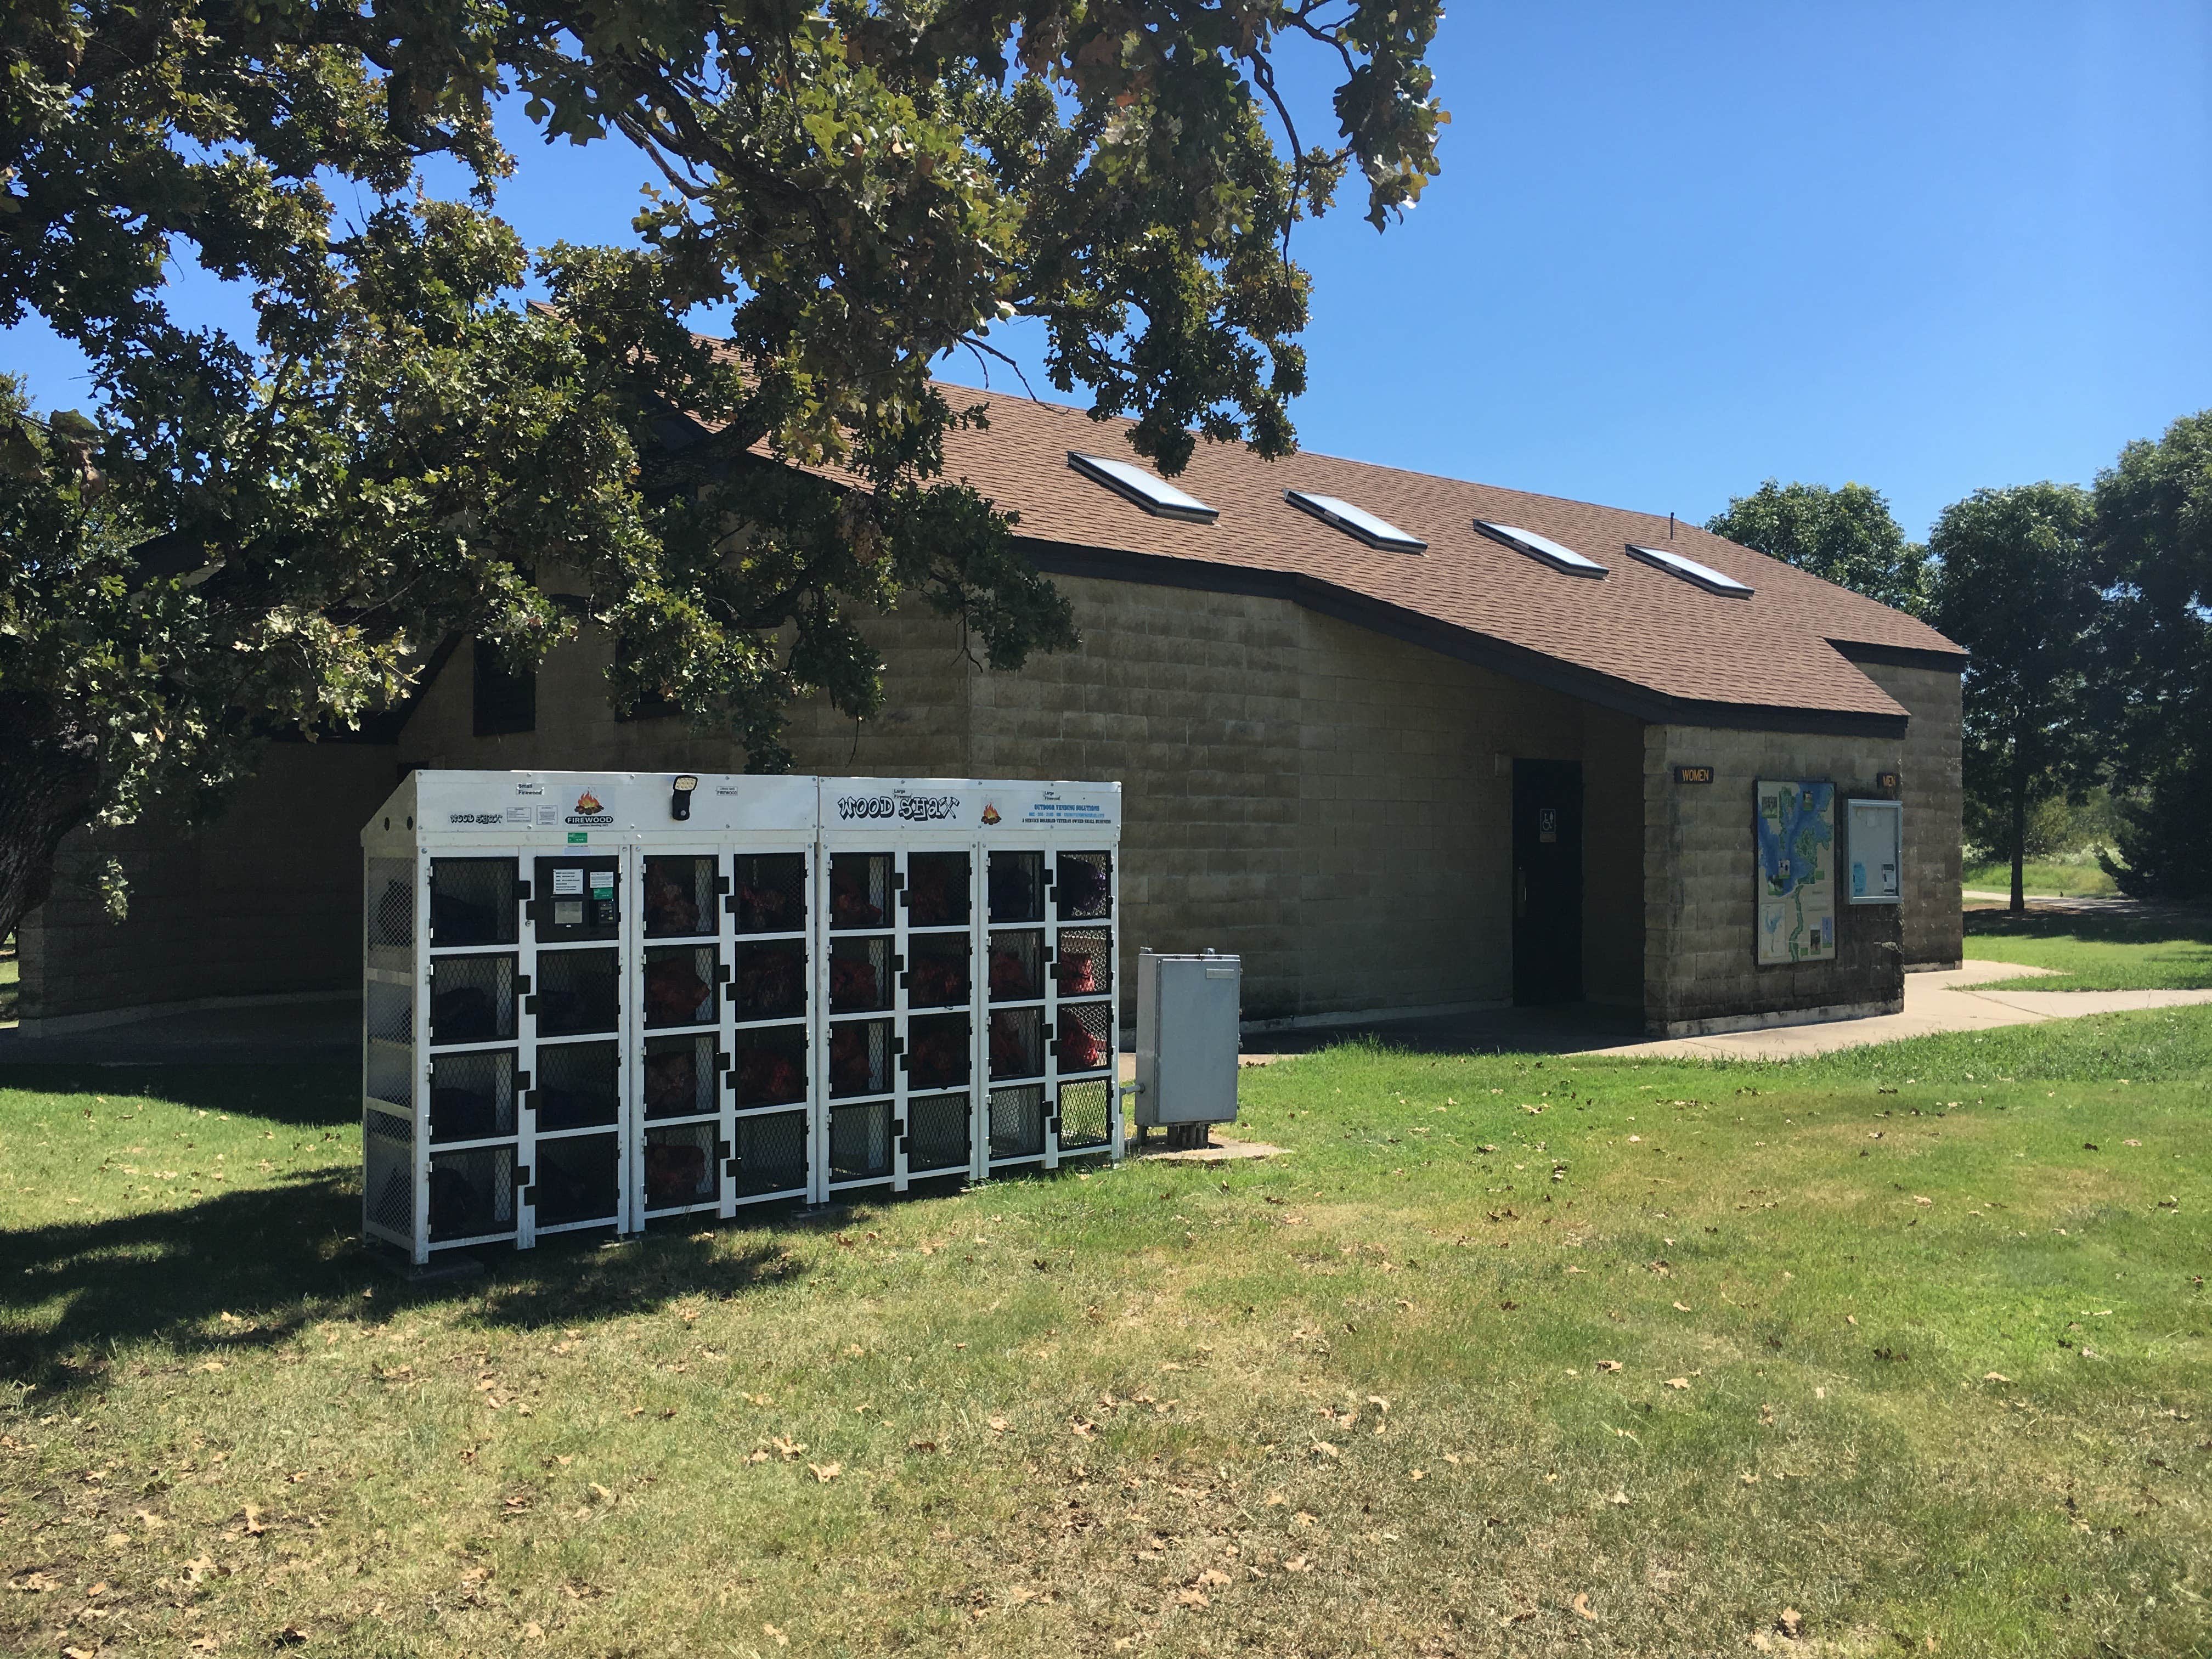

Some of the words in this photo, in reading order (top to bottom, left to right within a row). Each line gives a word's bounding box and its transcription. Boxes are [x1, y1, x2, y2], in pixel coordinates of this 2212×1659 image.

[1681, 769, 1709, 782] WOMEN
[1883, 775, 1897, 787] MEN
[838, 796, 895, 821] WOOD
